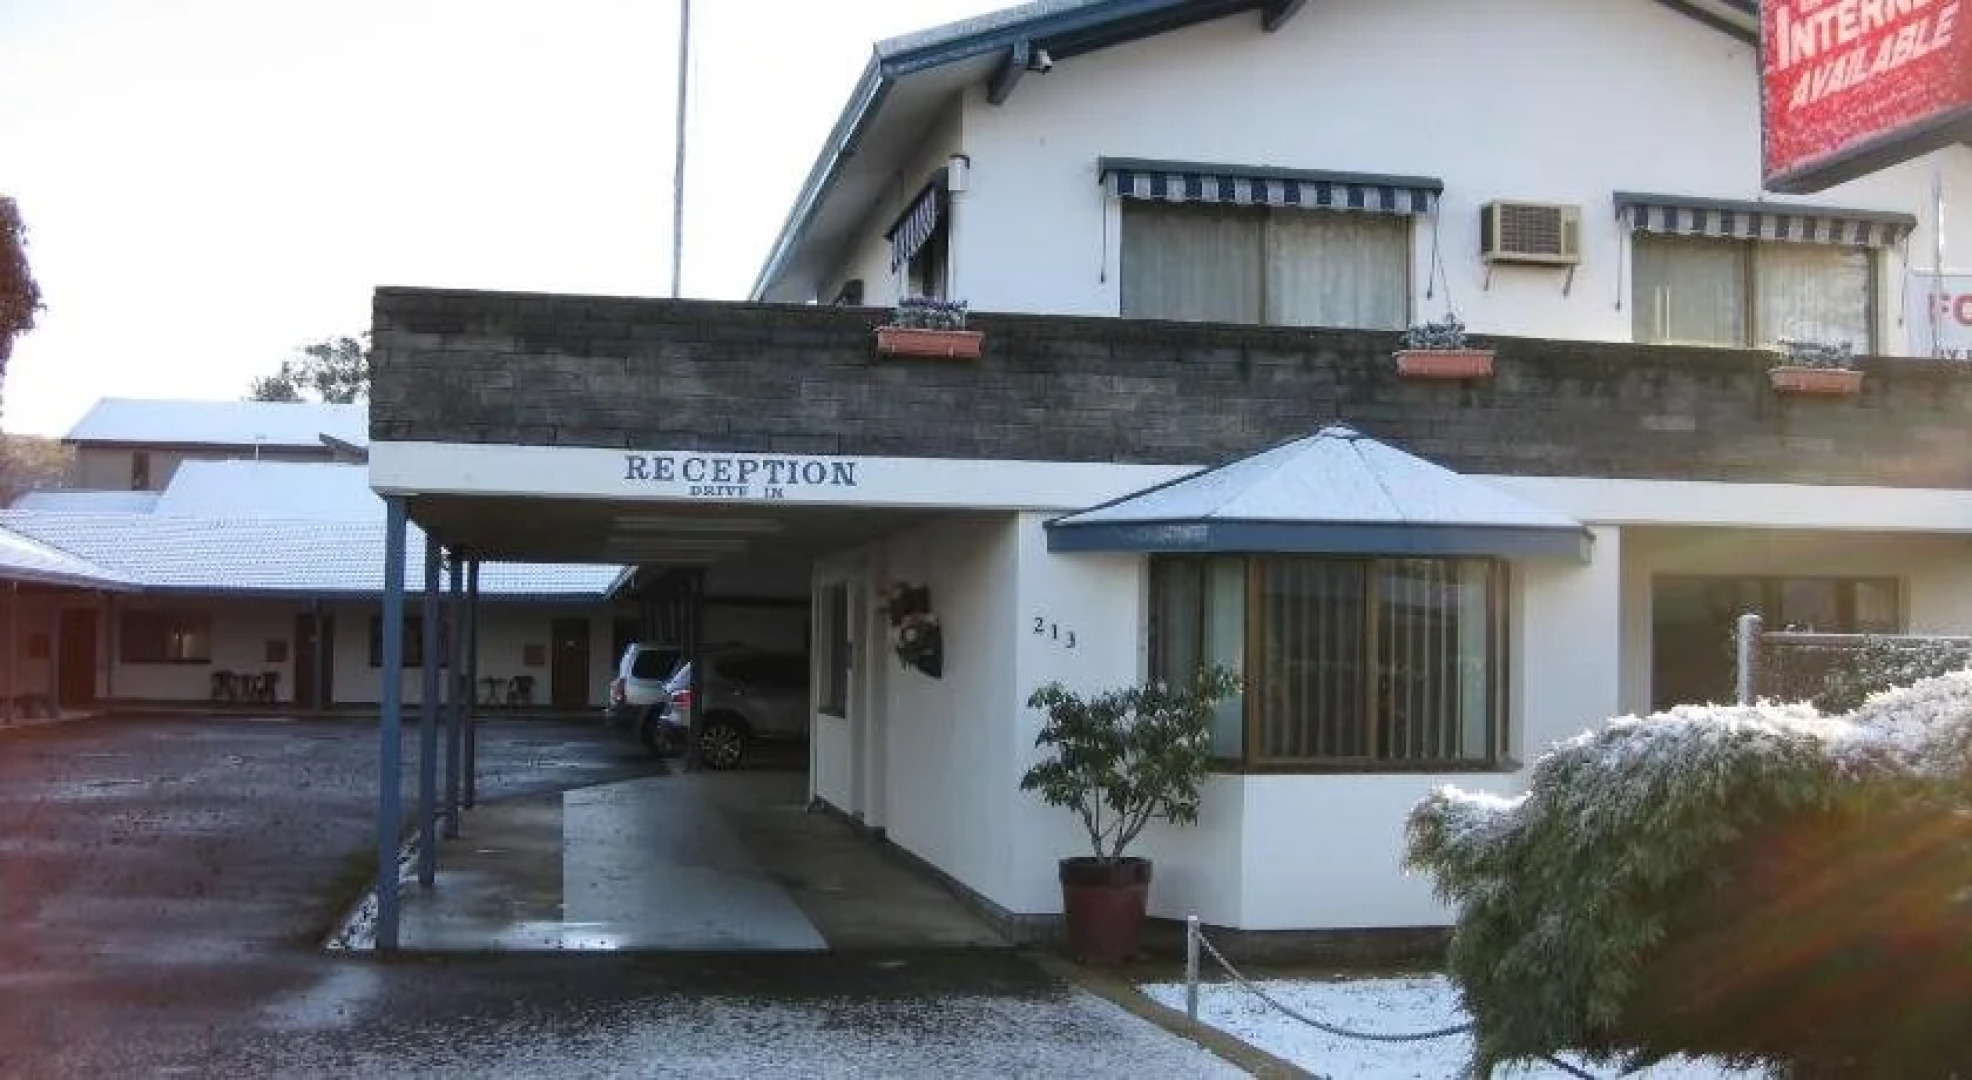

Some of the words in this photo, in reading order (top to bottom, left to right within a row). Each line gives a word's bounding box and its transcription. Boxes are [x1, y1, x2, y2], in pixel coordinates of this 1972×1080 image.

[1788, 4, 1959, 111] AVAILABLE
[624, 455, 857, 486] RECEPTION
[690, 485, 749, 496] DRIVE
[764, 487, 783, 498] IN
[1033, 616, 1076, 648] 213
